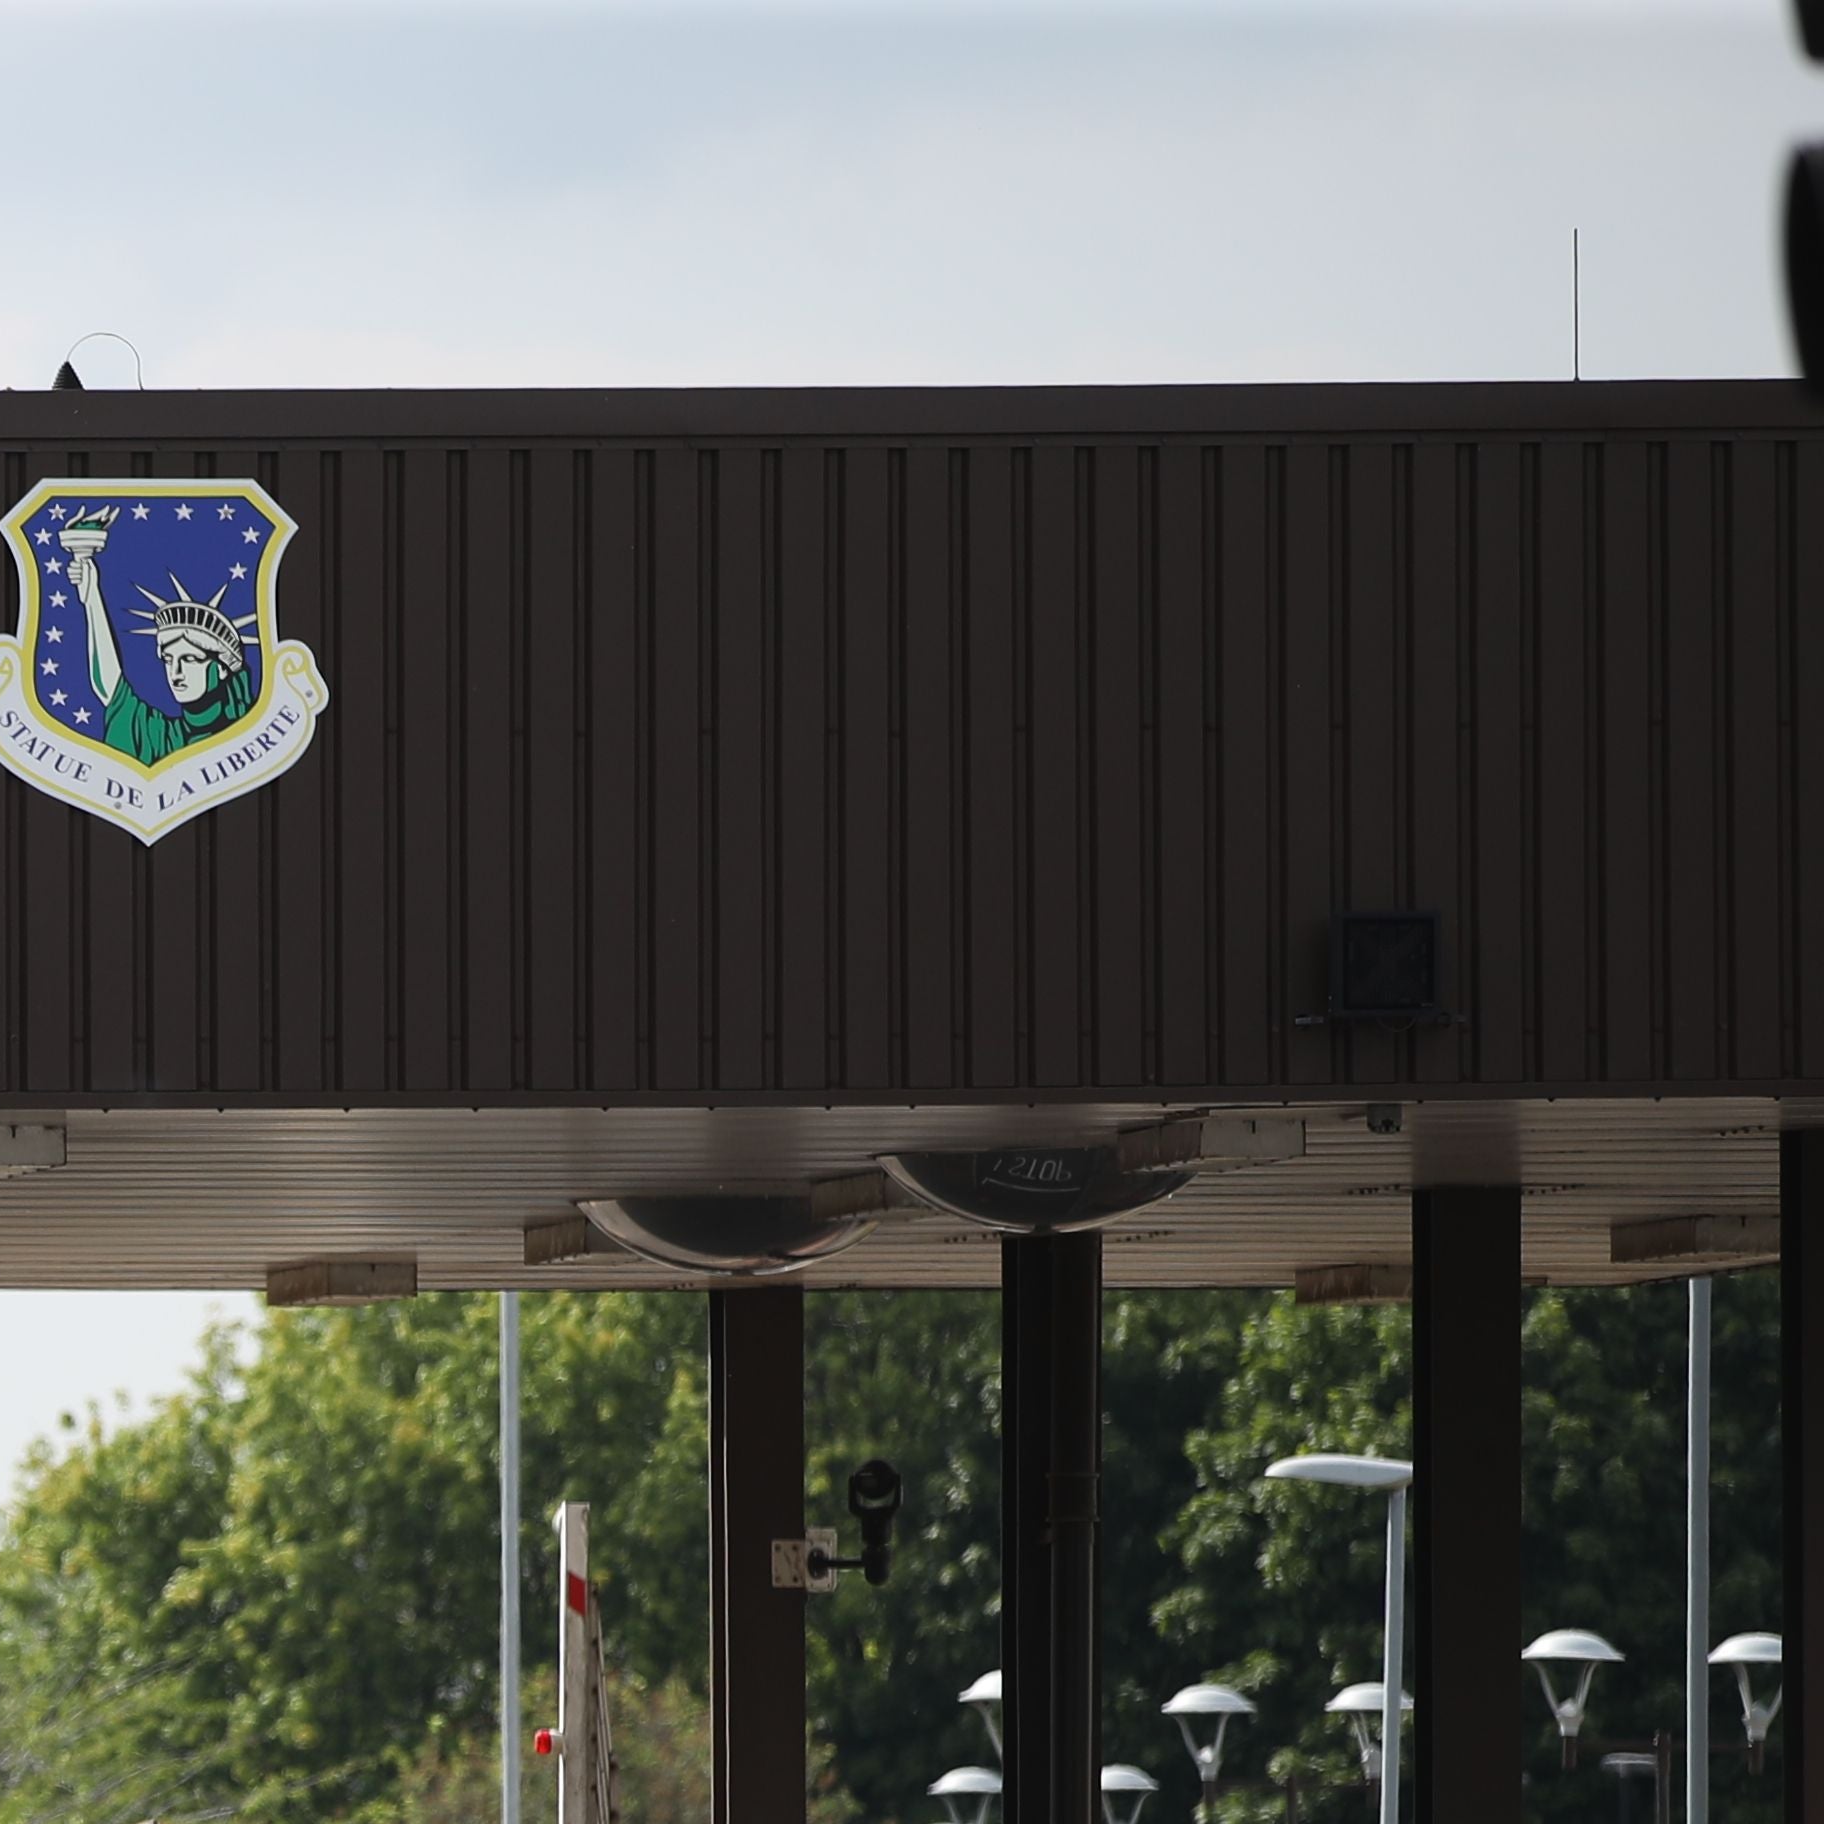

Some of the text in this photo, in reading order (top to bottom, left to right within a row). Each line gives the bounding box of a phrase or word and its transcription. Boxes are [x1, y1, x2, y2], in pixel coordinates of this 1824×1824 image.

[105, 777, 144, 809] DE
[157, 780, 195, 812] LA
[200, 704, 300, 786] LIBERTE
